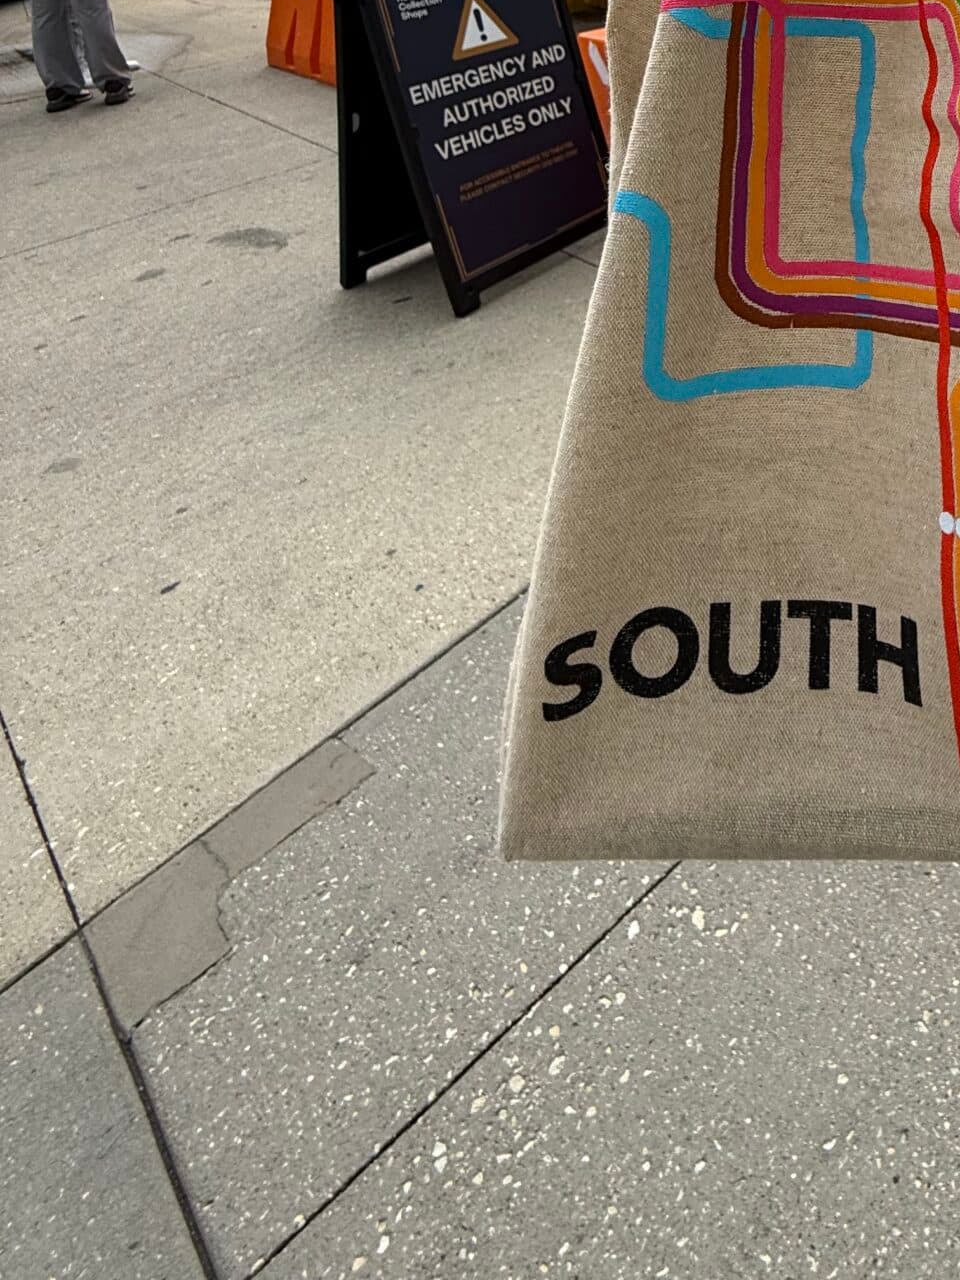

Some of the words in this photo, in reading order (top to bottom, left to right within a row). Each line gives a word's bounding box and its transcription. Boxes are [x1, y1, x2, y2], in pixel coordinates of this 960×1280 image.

[408, 53, 526, 106] EMERGENCY
[531, 44, 566, 69] AND
[442, 75, 556, 128] AUTHORIZED
[433, 114, 527, 161] VEHICLES
[527, 96, 572, 127] ONLY
[541, 599, 924, 722] SOUTH
